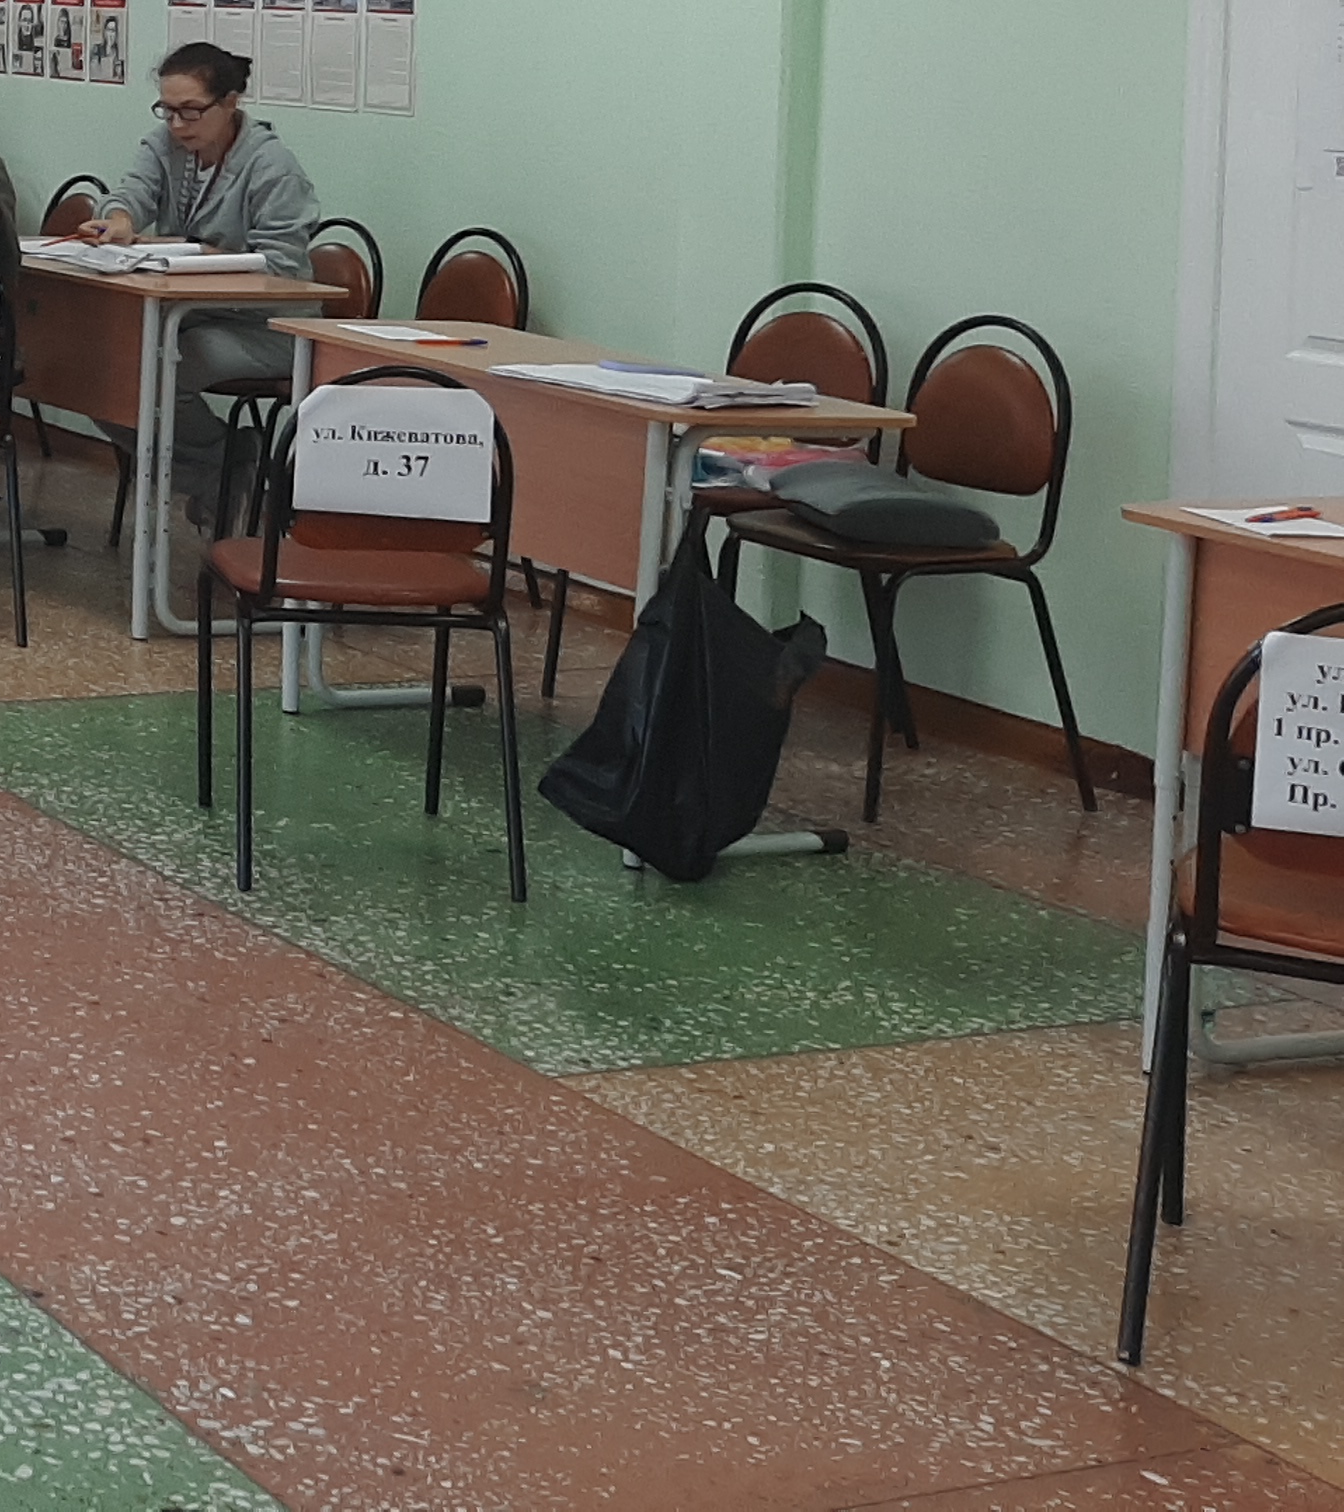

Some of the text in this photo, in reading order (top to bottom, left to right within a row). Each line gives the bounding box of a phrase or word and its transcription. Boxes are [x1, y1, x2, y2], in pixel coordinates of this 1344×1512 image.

[312, 424, 485, 448] ул. Кижеватова,
[362, 454, 430, 478] д. 37
[1284, 690, 1329, 713] ул.
[1272, 717, 1341, 748] 1 пр.
[1284, 756, 1329, 776] ул.
[1286, 782, 1338, 812] Пр.
